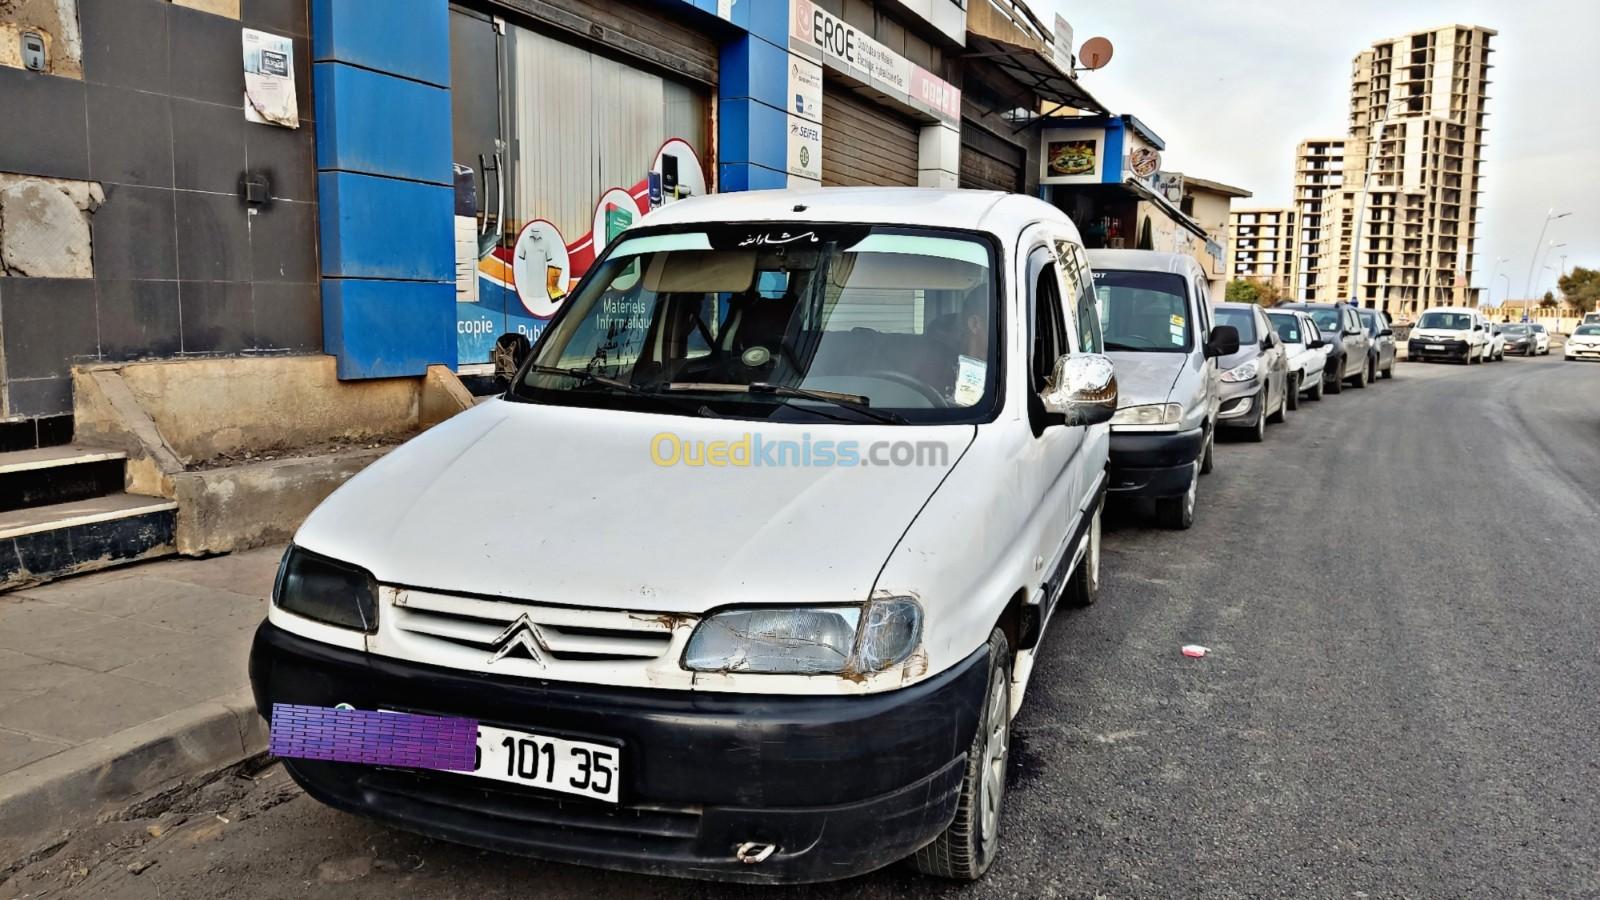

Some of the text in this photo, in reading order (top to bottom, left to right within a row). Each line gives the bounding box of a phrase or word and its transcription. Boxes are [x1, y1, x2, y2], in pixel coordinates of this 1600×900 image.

[813, 10, 854, 63] EROE
[603, 296, 646, 314] Matériels
[457, 315, 493, 339] copie
[518, 324, 548, 341] Publ
[502, 736, 555, 783] 101
[570, 747, 613, 794] 35
